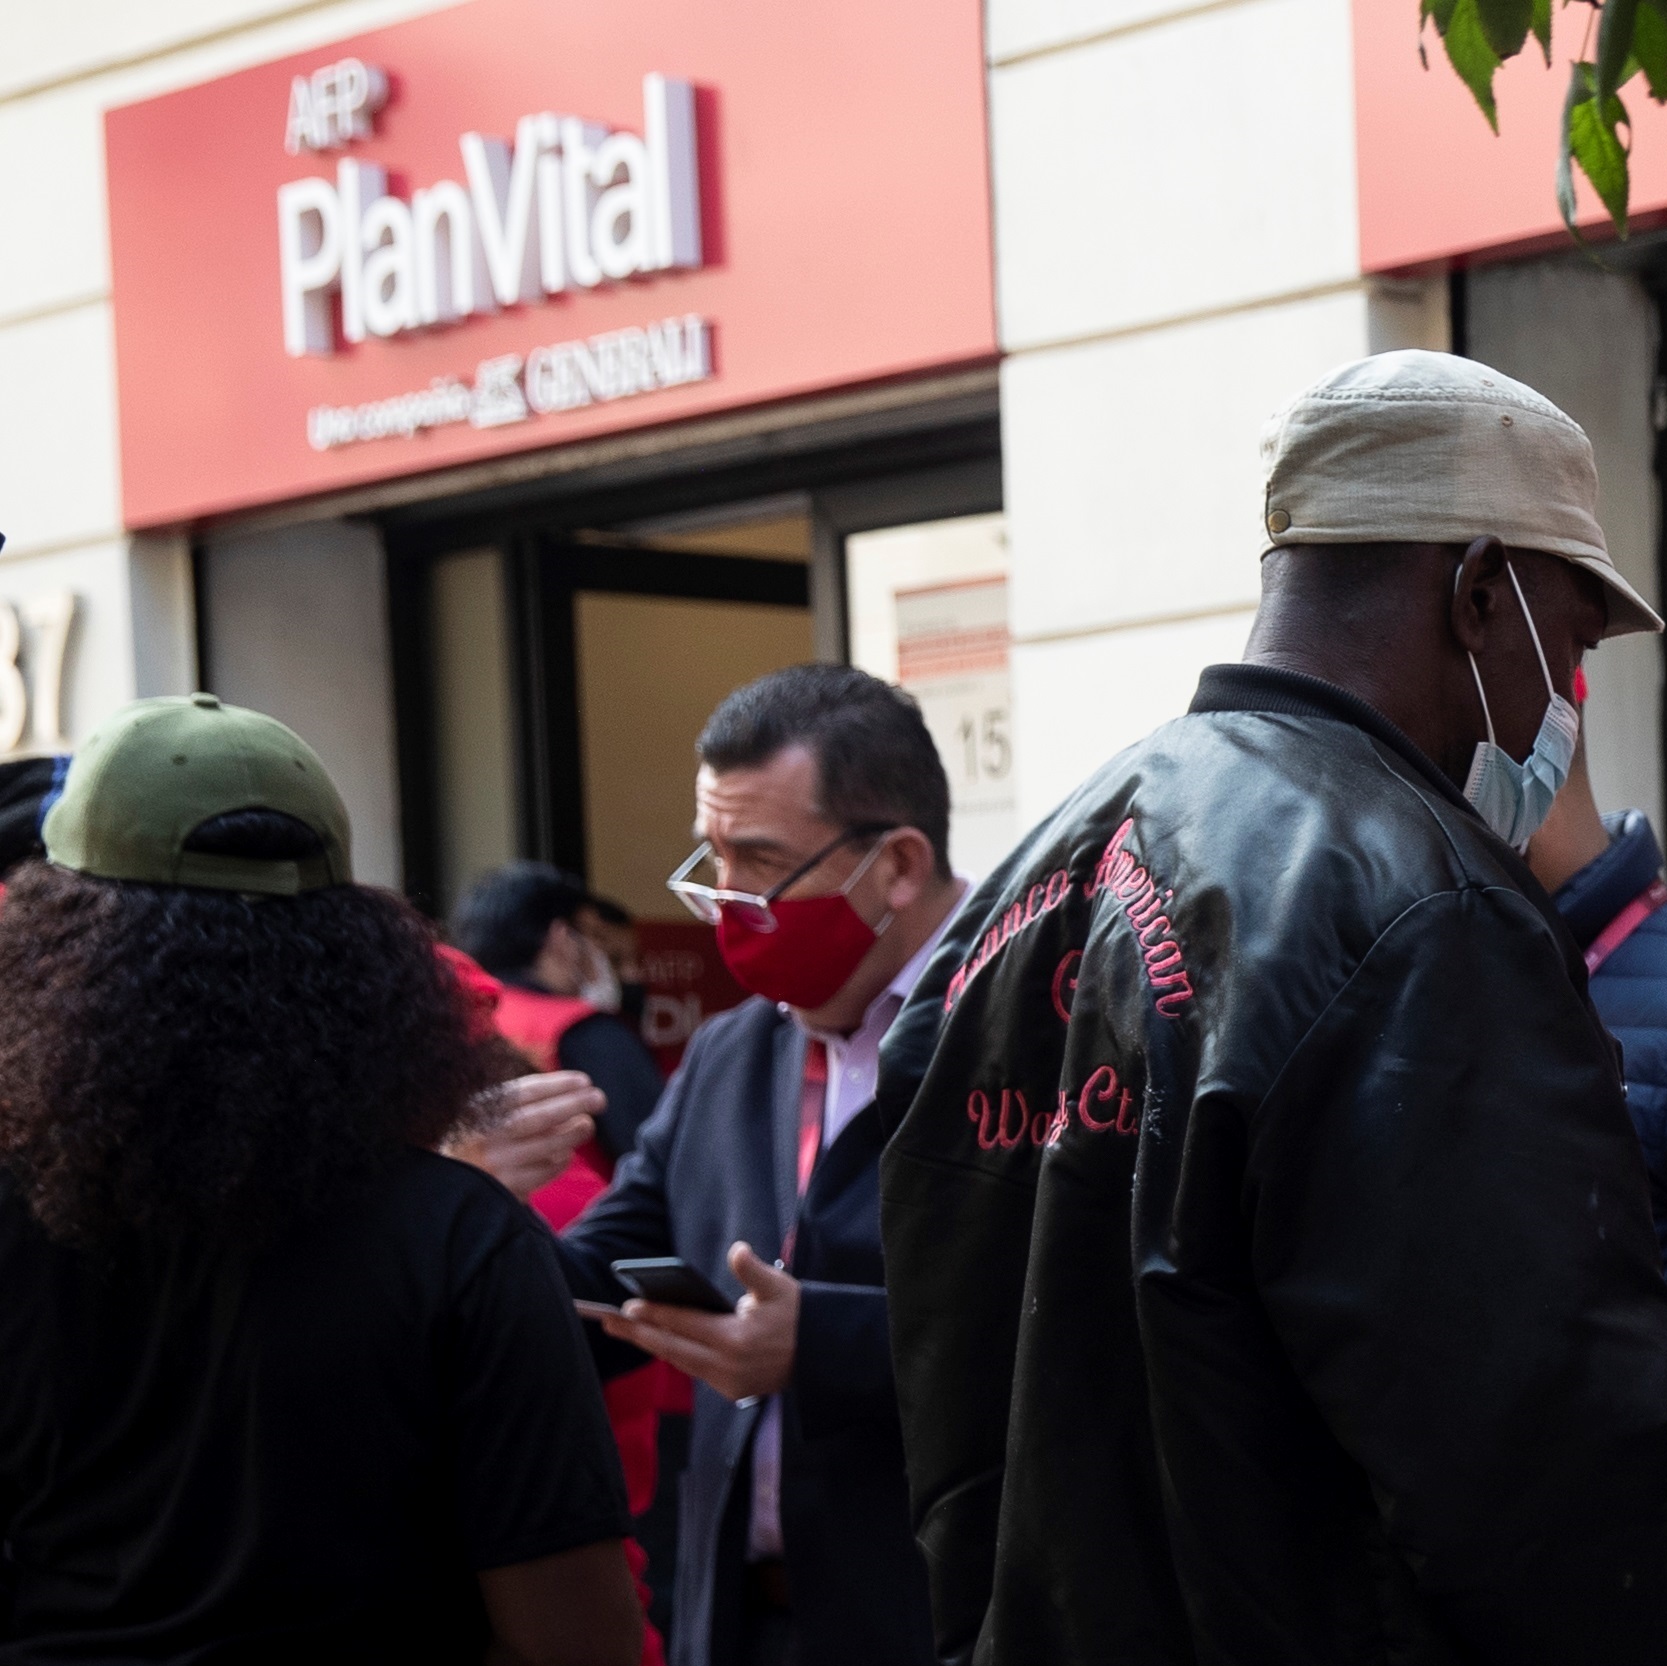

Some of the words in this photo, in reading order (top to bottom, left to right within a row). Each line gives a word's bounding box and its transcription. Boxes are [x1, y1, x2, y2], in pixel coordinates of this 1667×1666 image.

[283, 57, 384, 157] AFP
[279, 72, 701, 356] PlanVital
[524, 314, 713, 413] GENERALI
[1084, 817, 1194, 1018] American
[1077, 1064, 1140, 1136] Ct.
